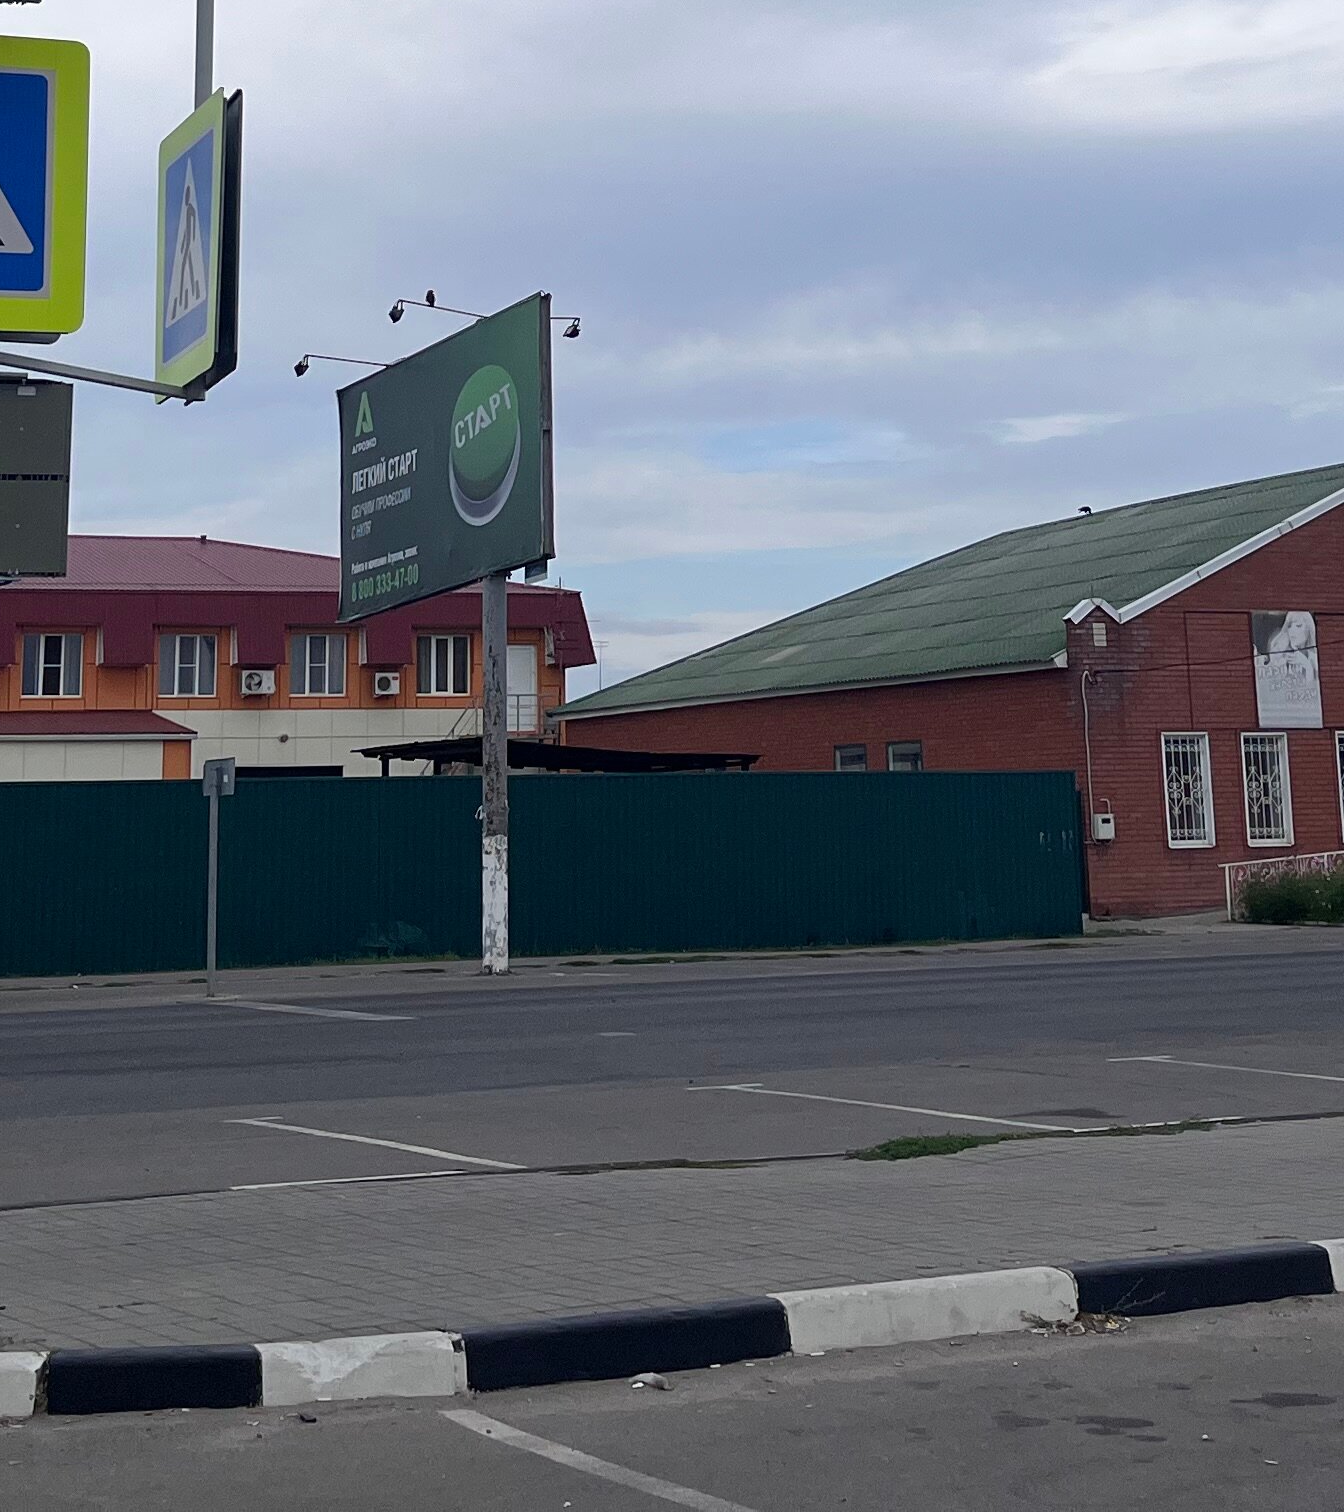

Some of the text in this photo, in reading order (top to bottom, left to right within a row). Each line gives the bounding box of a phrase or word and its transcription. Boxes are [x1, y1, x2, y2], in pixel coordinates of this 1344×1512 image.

[455, 383, 511, 448] СТАРТ
[352, 448, 418, 494] ЛЕГКИЙ СТАРТ
[358, 577, 374, 600] 800
[376, 563, 419, 595] 333-47-00
